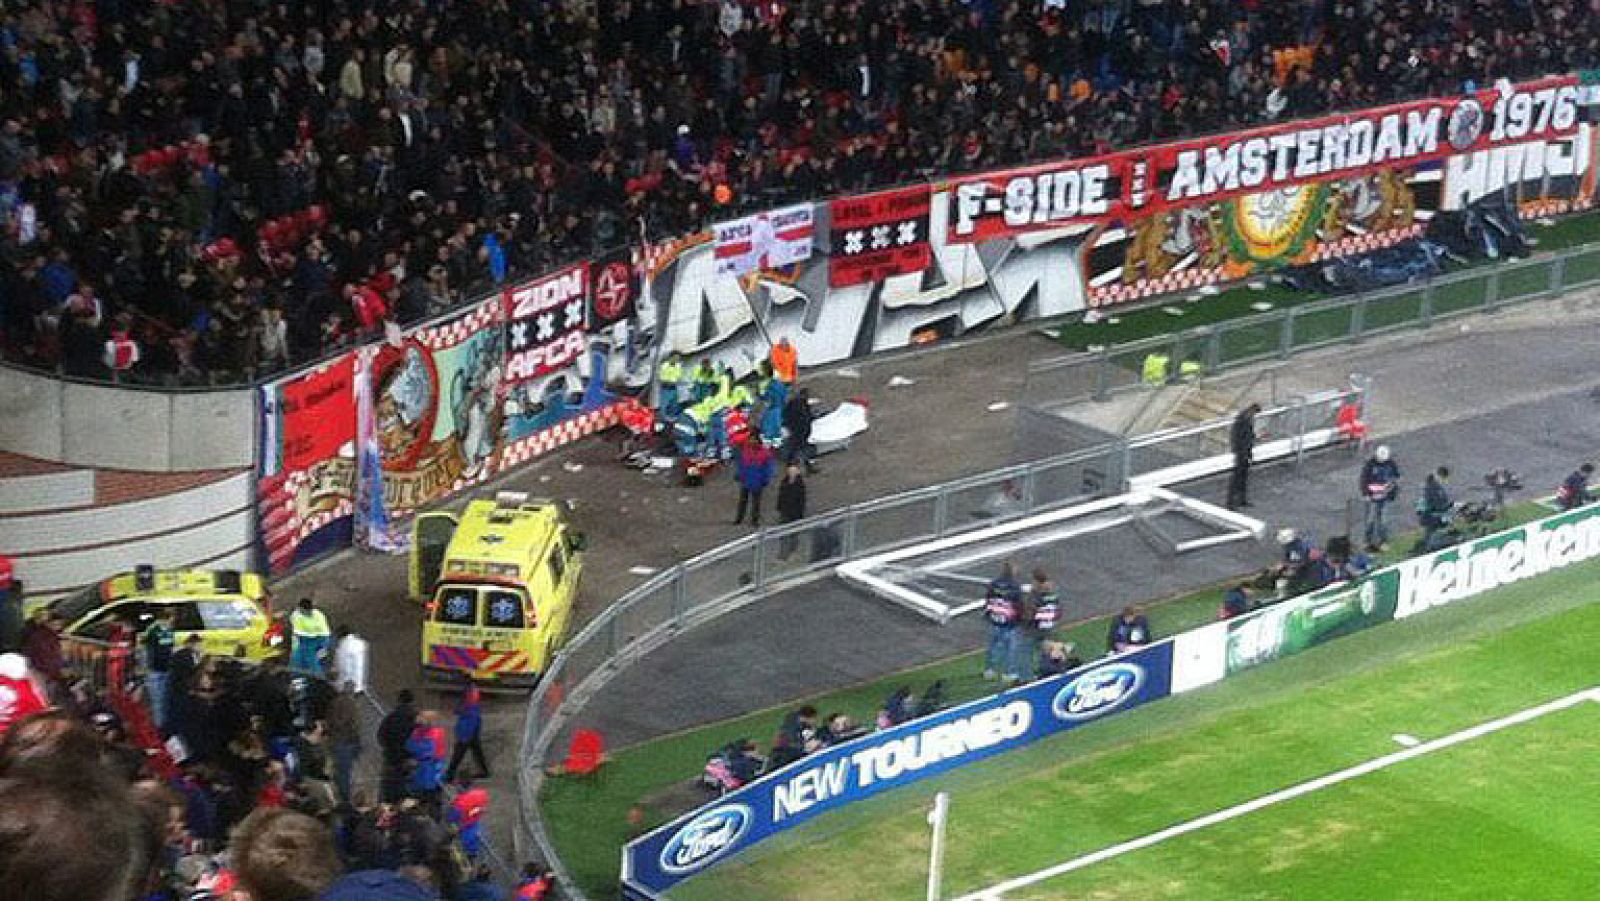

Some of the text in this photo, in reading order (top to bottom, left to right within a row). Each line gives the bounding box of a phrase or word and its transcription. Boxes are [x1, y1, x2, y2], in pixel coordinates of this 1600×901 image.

[955, 164, 1109, 235] F-SIDE
[1166, 107, 1443, 201] AMSTERDAM
[1489, 86, 1576, 141] 1976
[512, 268, 583, 318] ZION
[506, 330, 586, 380] AFCA
[1394, 514, 1600, 619] Heineken
[1068, 672, 1125, 713] Ford
[772, 700, 1033, 823] NEW TOURNEO
[676, 815, 735, 865] Ford
